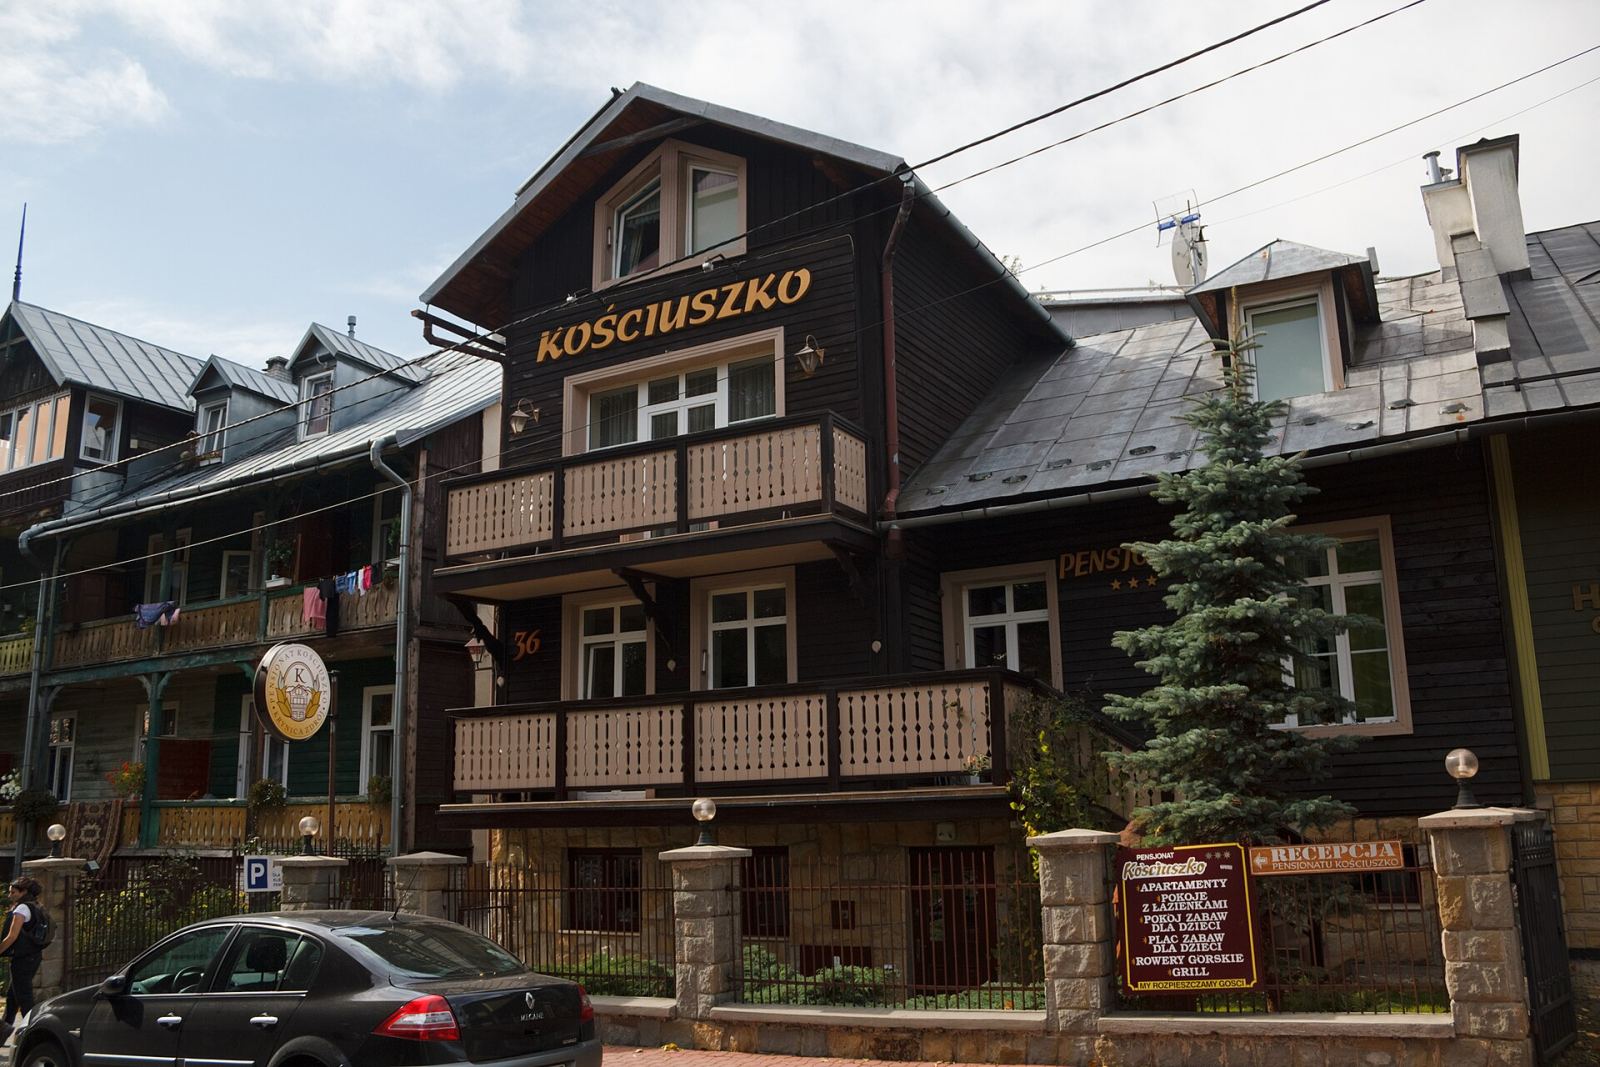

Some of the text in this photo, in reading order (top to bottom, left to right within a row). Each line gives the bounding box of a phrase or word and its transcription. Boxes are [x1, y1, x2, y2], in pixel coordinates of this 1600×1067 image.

[536, 268, 811, 363] KOŚCIUSZKO
[1059, 547, 1147, 579] PENSJO
[512, 629, 541, 661] 36
[295, 668, 307, 684] K
[1136, 852, 1175, 861] PENSJONAT
[1271, 843, 1396, 862] RECEPCJA
[251, 863, 265, 885] P
[1140, 879, 1228, 892] APARTAMENTY
[1161, 892, 1208, 903] POKOJE
[1142, 900, 1228, 913] Z ŁAZIENKAMI
[1186, 912, 1228, 922] ZABAW
[1152, 921, 1221, 933] DLA DZIECI
[1148, 932, 1225, 945] PLAC ZABAW
[1153, 942, 1222, 953] DLA DZIECI
[1136, 956, 1185, 966] ROWERY
[1172, 967, 1210, 977] GRILL
[1152, 980, 1218, 989] ROZPIESZCZAMY
